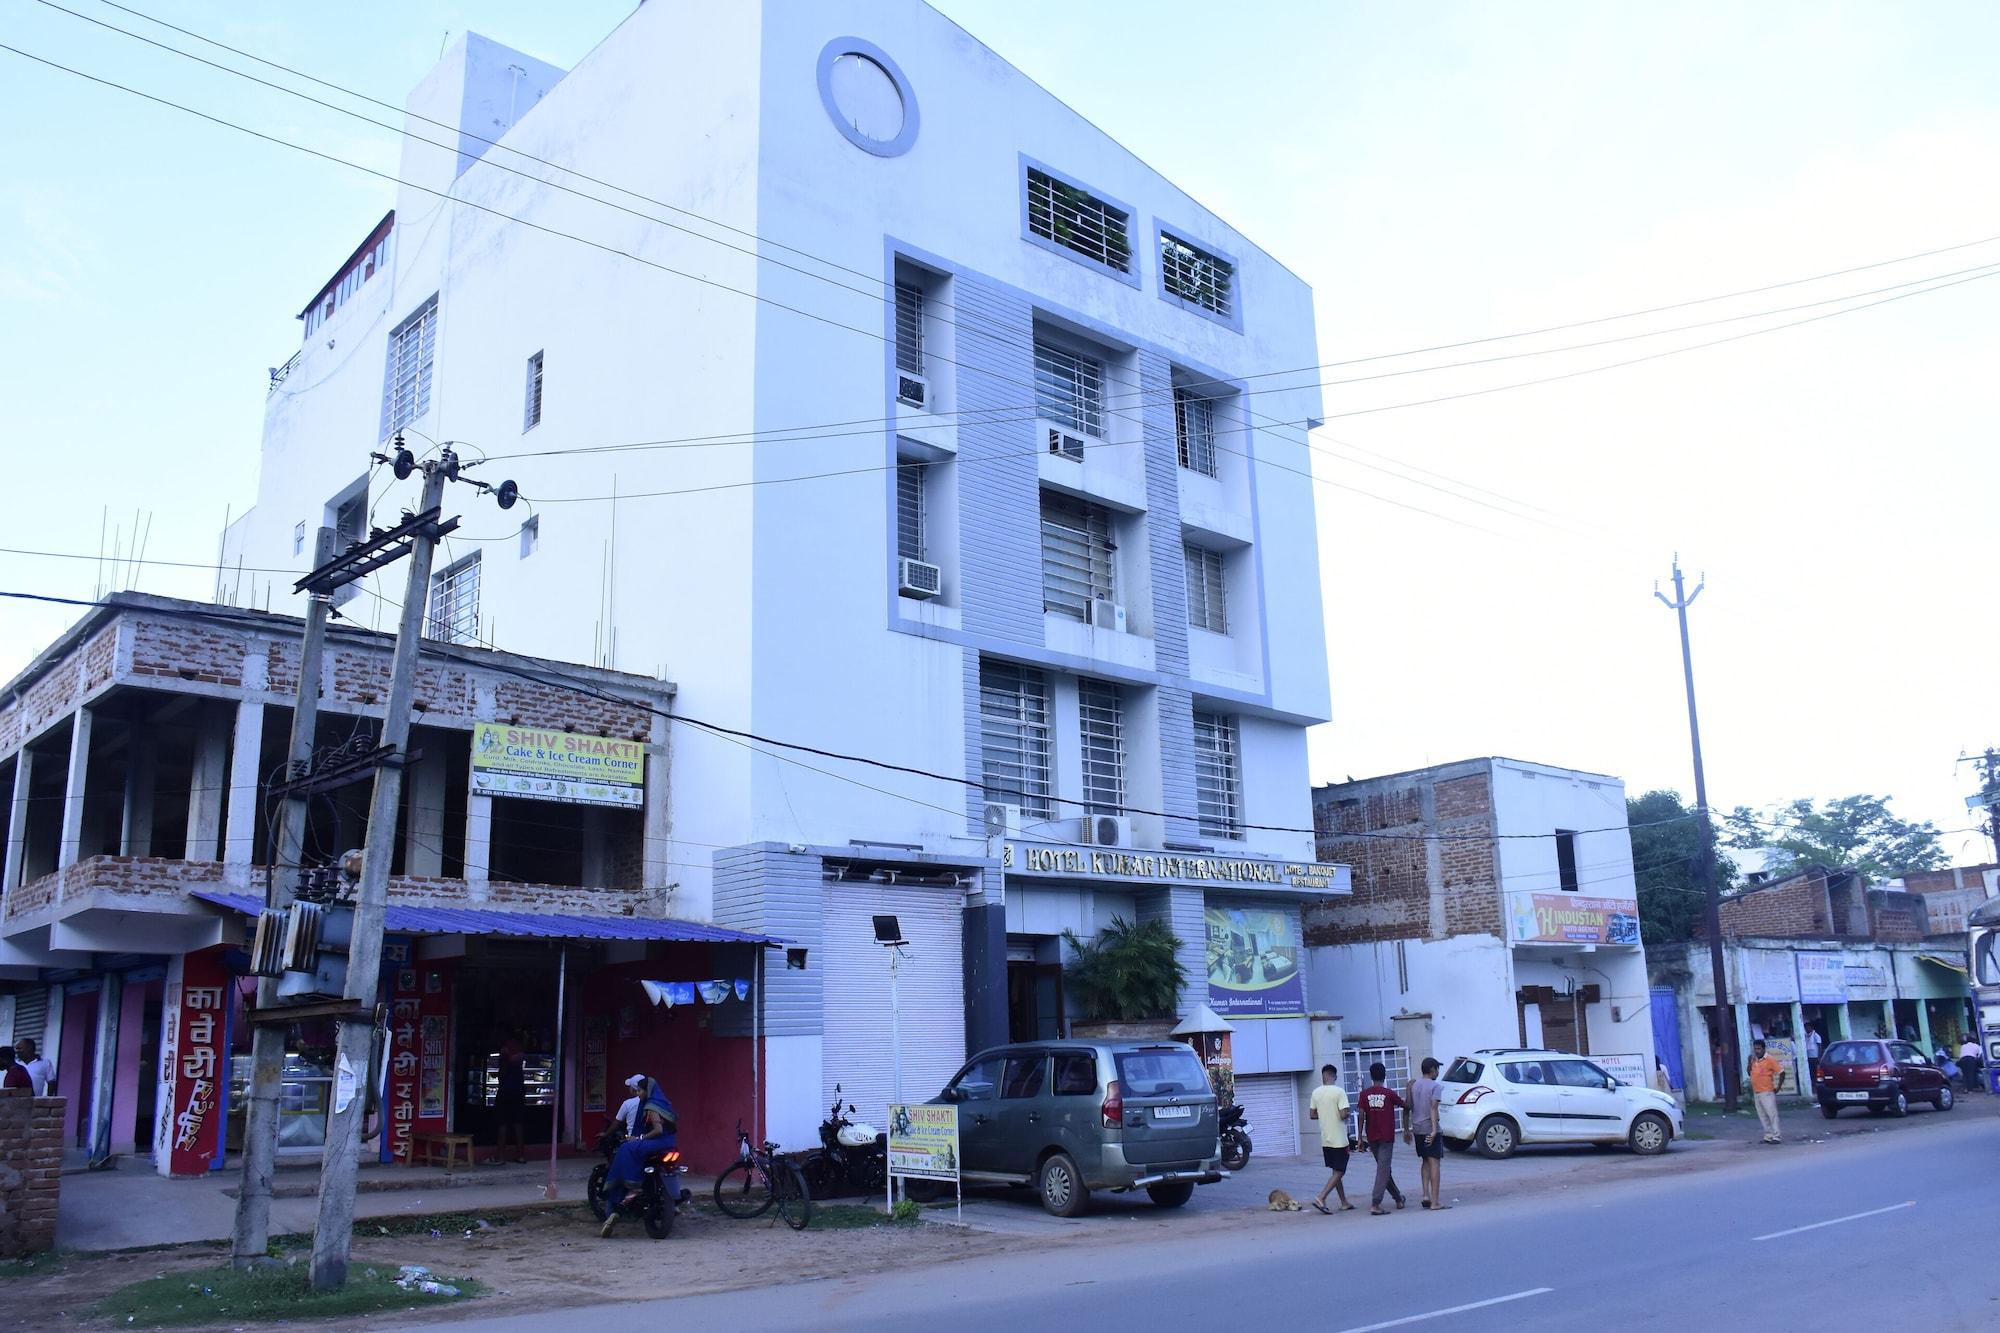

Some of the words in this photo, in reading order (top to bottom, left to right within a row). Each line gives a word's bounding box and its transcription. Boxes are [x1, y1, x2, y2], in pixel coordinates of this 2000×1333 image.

[506, 746, 531, 758] Cake
[536, 749, 546, 759] &
[550, 751, 564, 762] Ice
[568, 752, 600, 766] Cream
[604, 757, 638, 770] Corner
[507, 730, 558, 748] SHIV
[564, 736, 639, 758] SHAKTI
[1026, 847, 1085, 874] HOTEL
[1092, 852, 1154, 878] KUMAR
[1158, 856, 1281, 884] INTERNATIONAL
[1537, 907, 1604, 936] HINDUSTAN
[183, 986, 223, 1079] कावेरी
[394, 998, 421, 1078] कावेरी
[424, 1040, 443, 1056] SHIV
[909, 1109, 925, 1121] SHIV
[927, 1110, 953, 1123] SHAKTI
